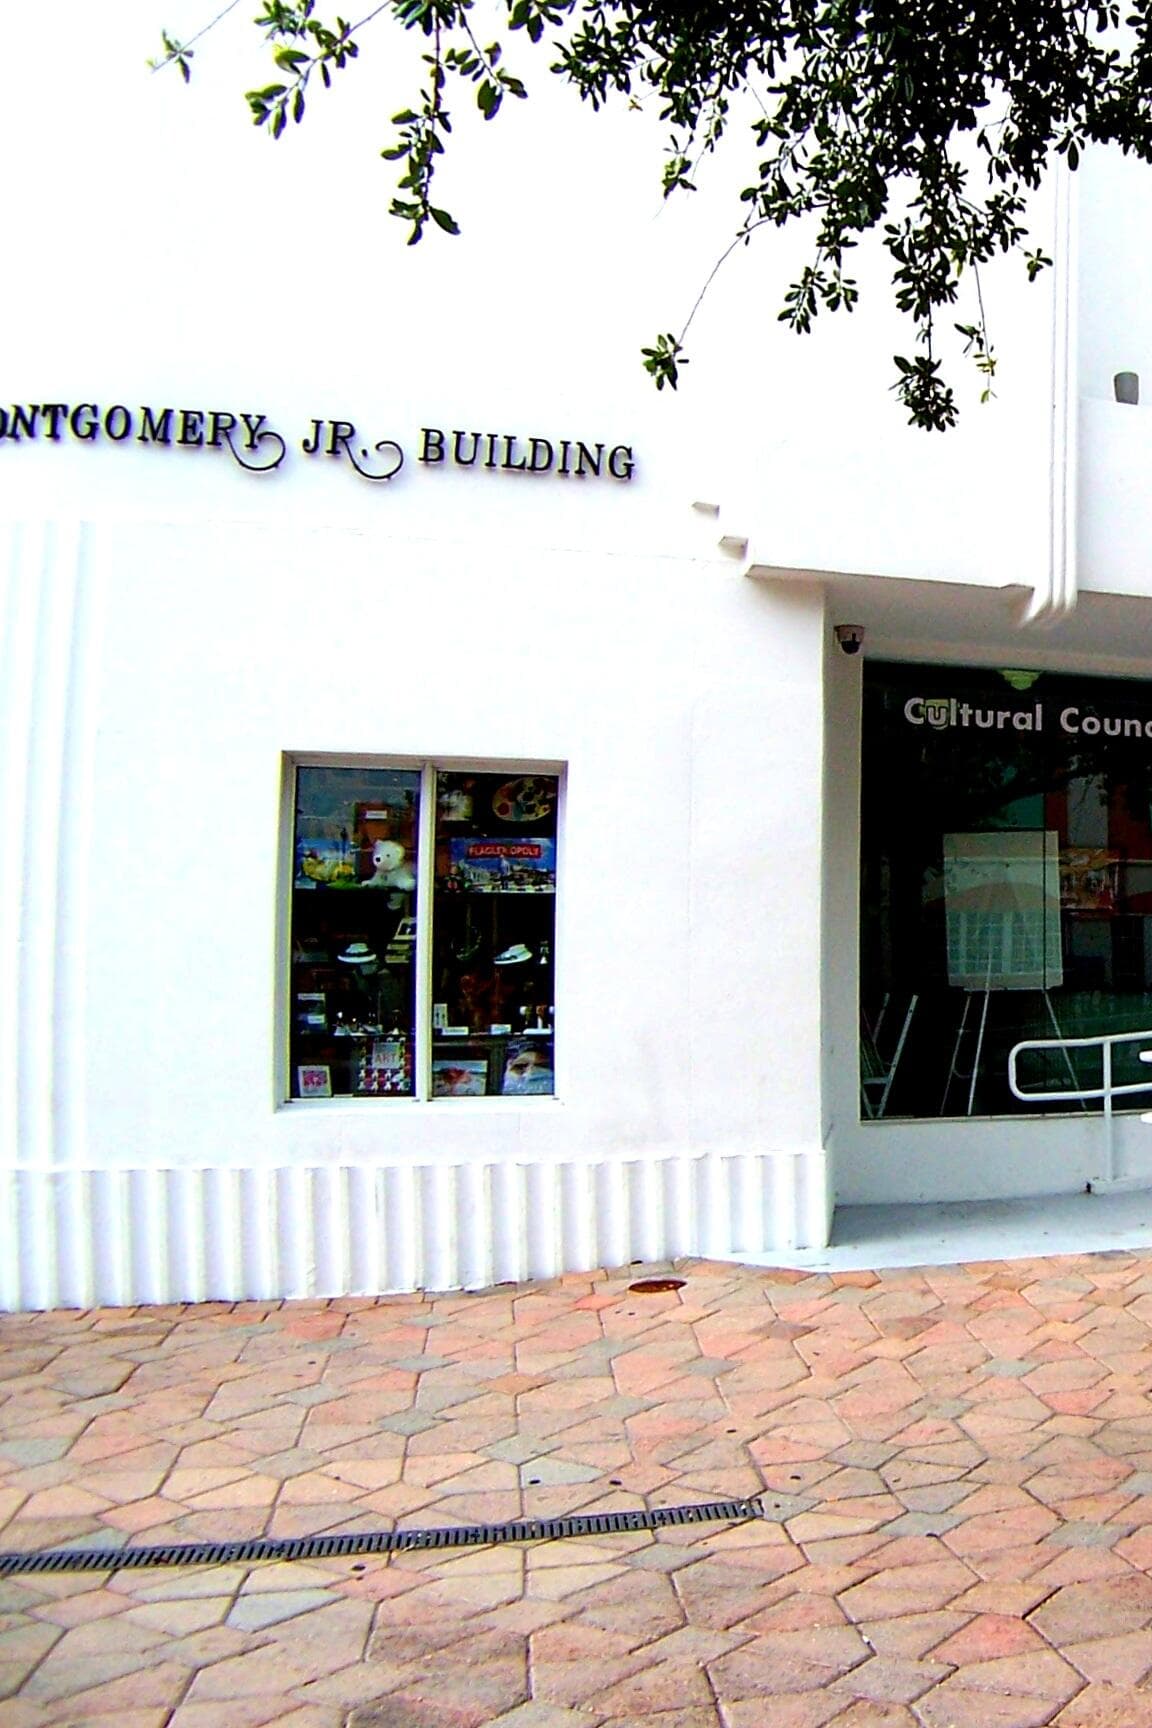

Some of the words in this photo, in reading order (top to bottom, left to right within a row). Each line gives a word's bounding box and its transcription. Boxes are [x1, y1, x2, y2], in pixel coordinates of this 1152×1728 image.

[303, 420, 403, 480] JR.
[419, 429, 634, 480] BUILDING
[905, 698, 1042, 730] Cultural
